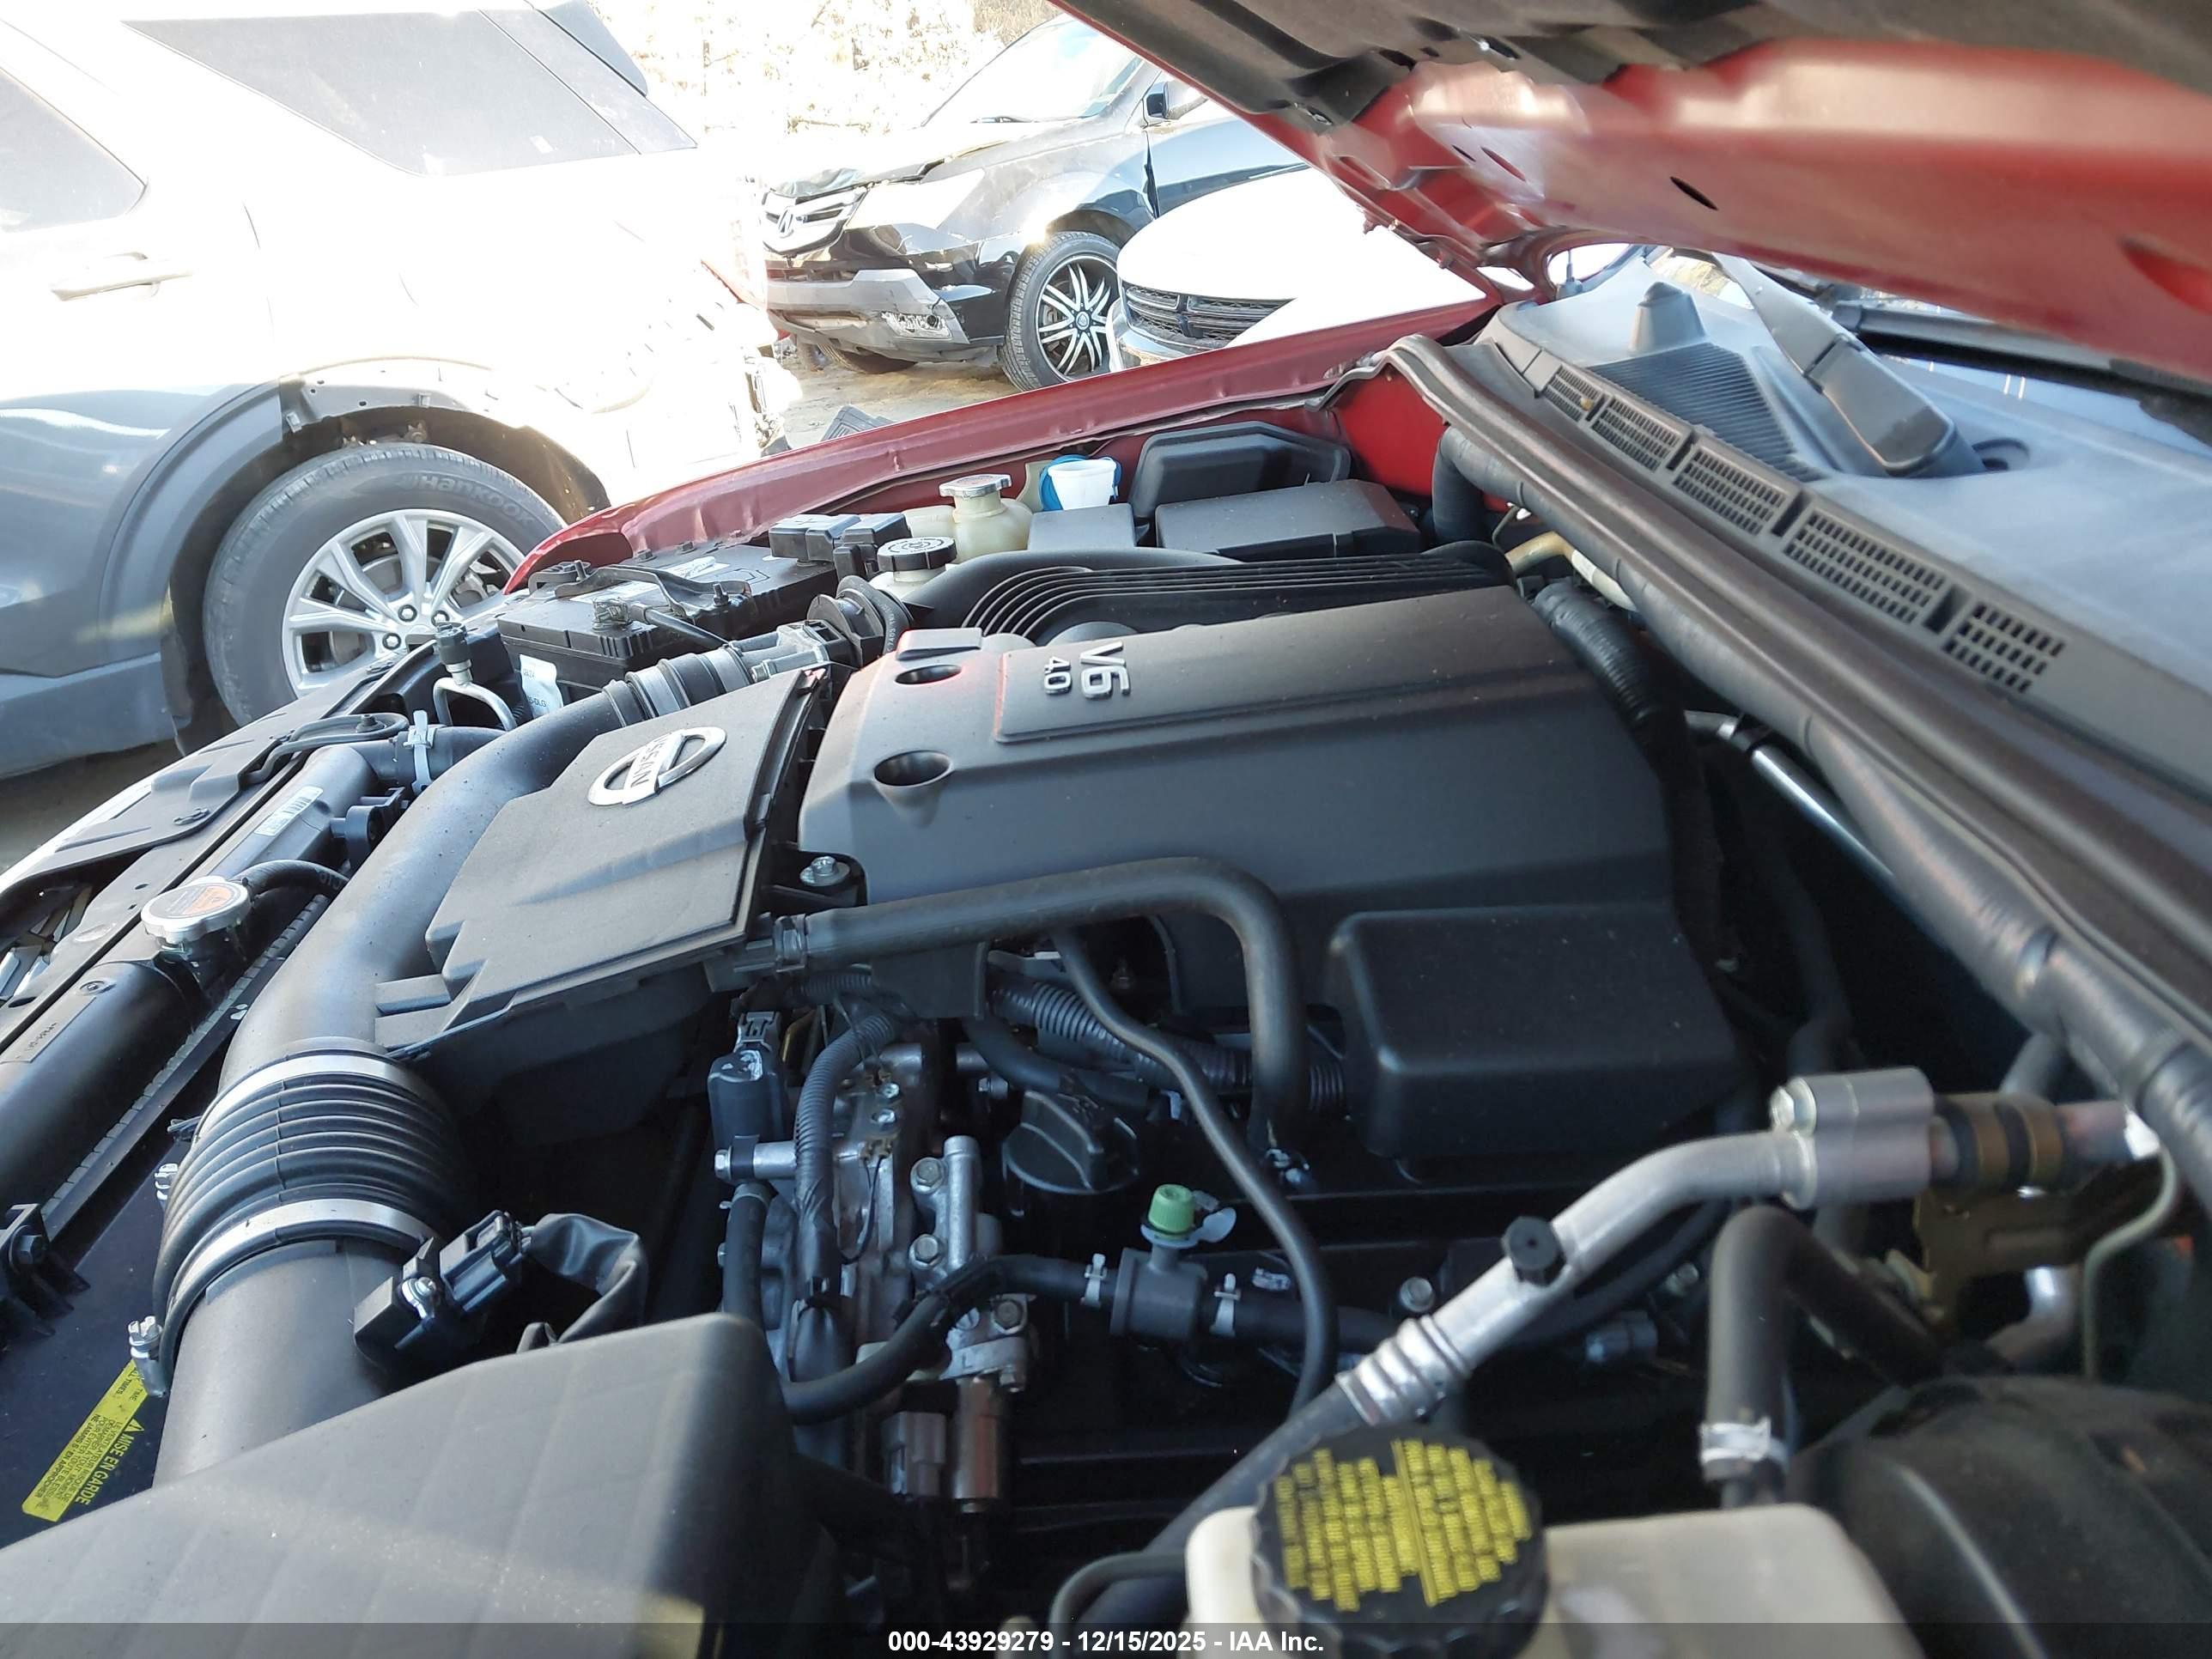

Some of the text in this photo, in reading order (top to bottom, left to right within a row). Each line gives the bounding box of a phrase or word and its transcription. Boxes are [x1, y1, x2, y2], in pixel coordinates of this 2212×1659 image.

[1079, 641, 1131, 698] V6
[75, 1432, 135, 1505] MISE EN GARDE
